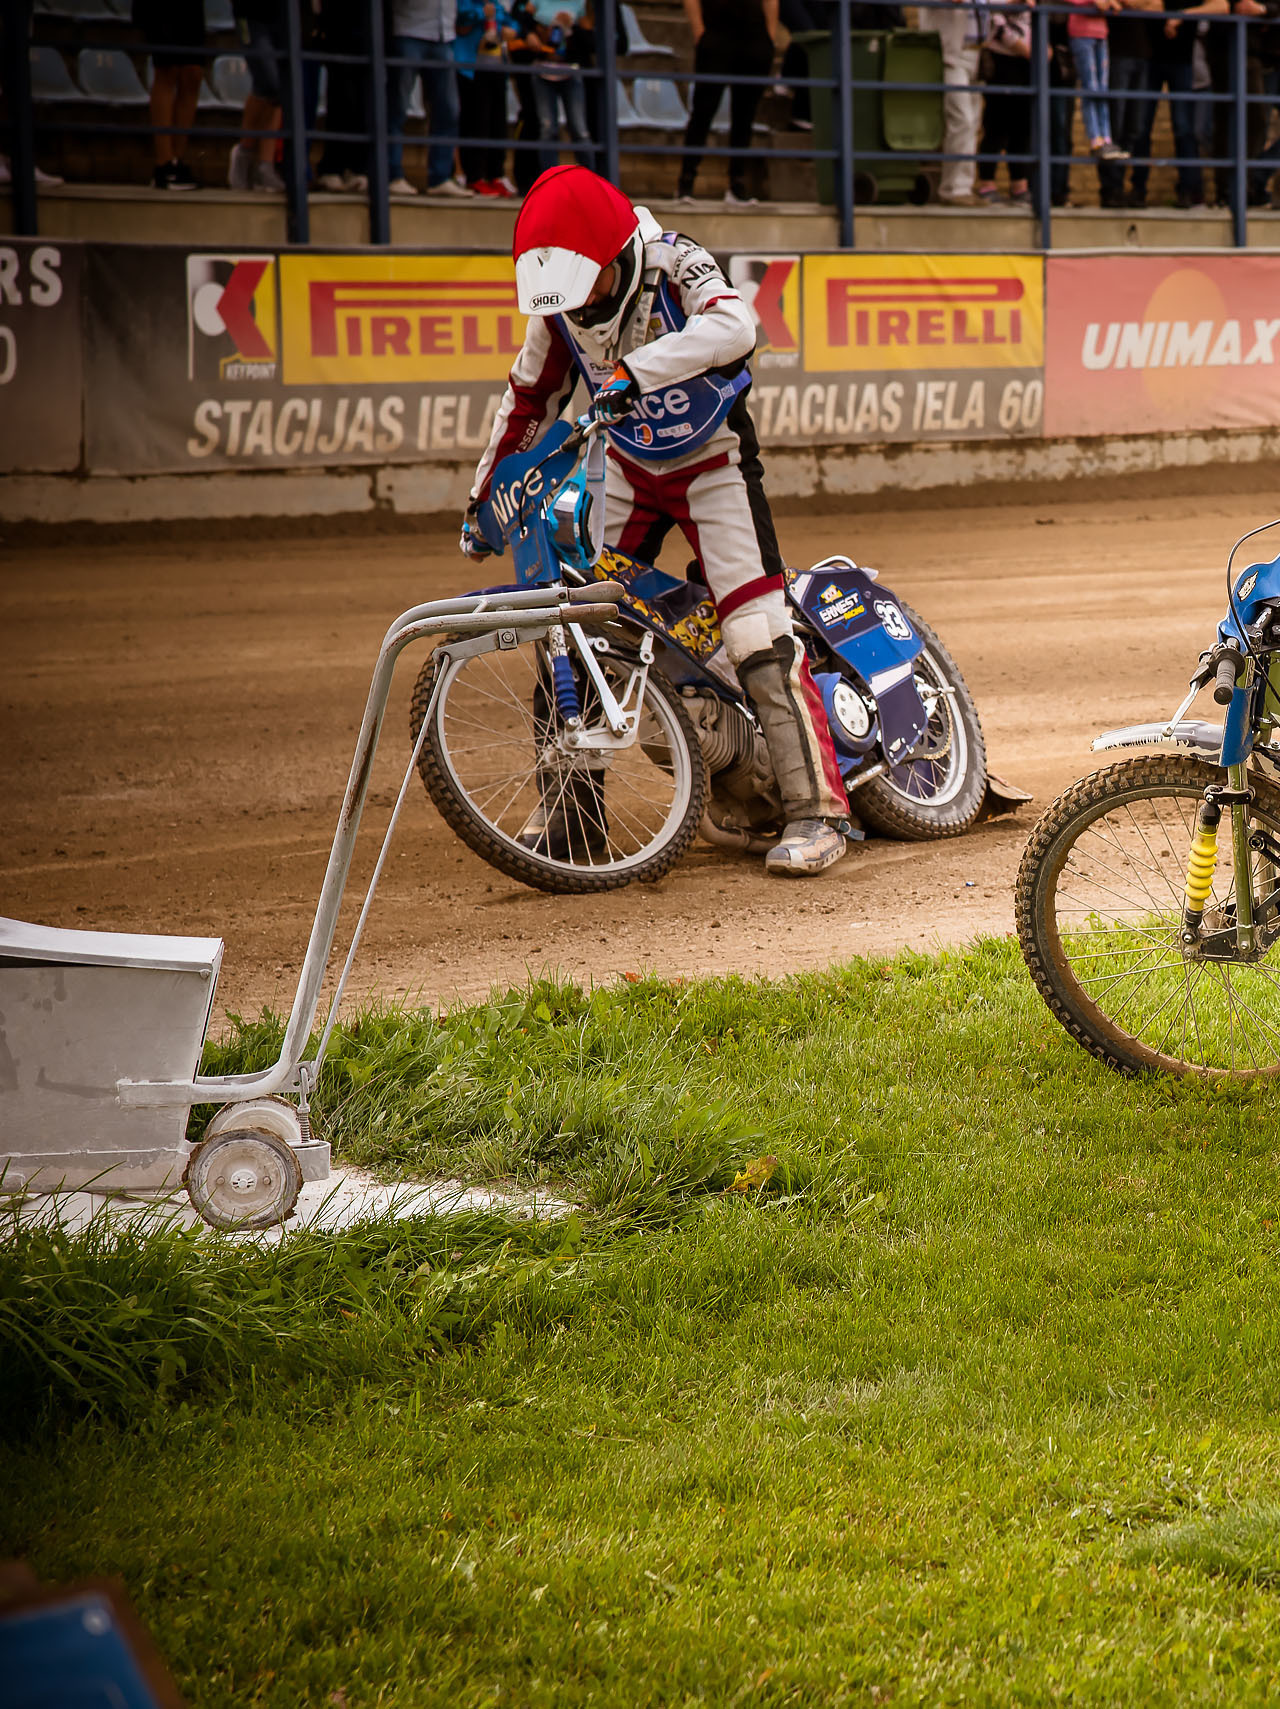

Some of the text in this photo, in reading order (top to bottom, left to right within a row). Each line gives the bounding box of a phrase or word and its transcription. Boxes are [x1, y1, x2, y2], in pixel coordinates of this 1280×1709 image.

[309, 281, 523, 356] PIRELL
[532, 295, 559, 309] SHOEI
[826, 277, 1025, 348] PIRELLI
[187, 394, 406, 458] STACIJAS
[630, 388, 690, 420] ice
[746, 379, 1043, 437] TACIJAS IELA 60
[491, 467, 543, 534] Nice
[819, 592, 858, 623] ERNEST
[875, 602, 911, 638] 33
